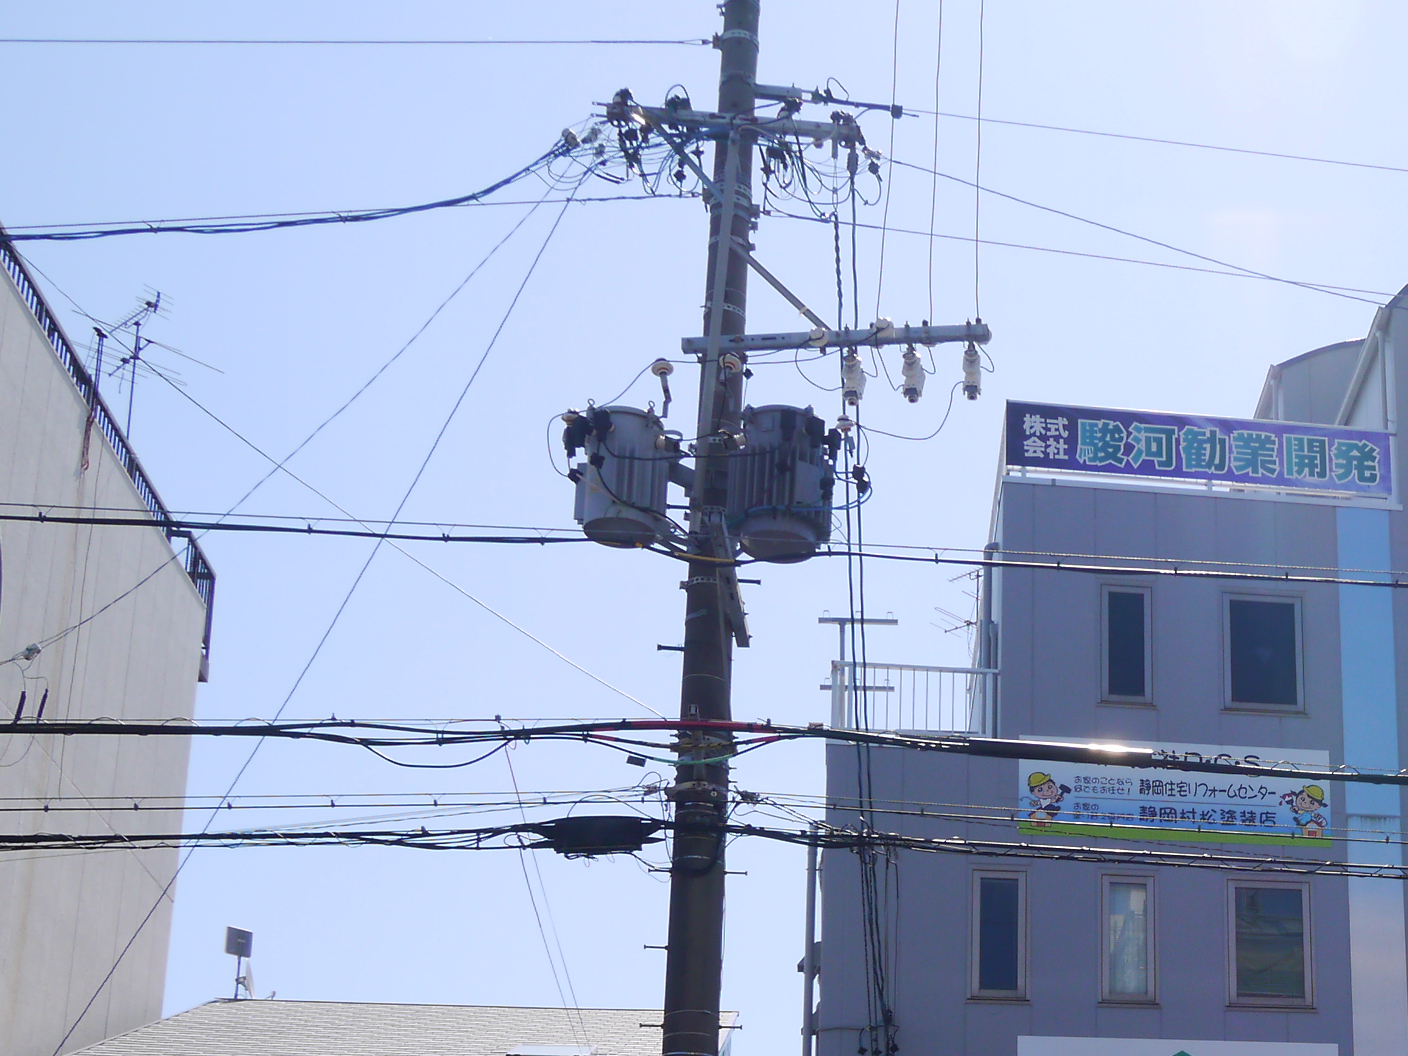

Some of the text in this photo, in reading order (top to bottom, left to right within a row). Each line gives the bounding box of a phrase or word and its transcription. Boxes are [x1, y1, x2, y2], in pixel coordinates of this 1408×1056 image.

[1023, 413, 1069, 438] 株式
[1023, 437, 1069, 460] 会社
[1075, 418, 1381, 486] 駿河勧業開発
[1138, 777, 1278, 801] 静岡住宅リフォームセンター
[1138, 805, 1277, 828] 静岡村松塗装店
